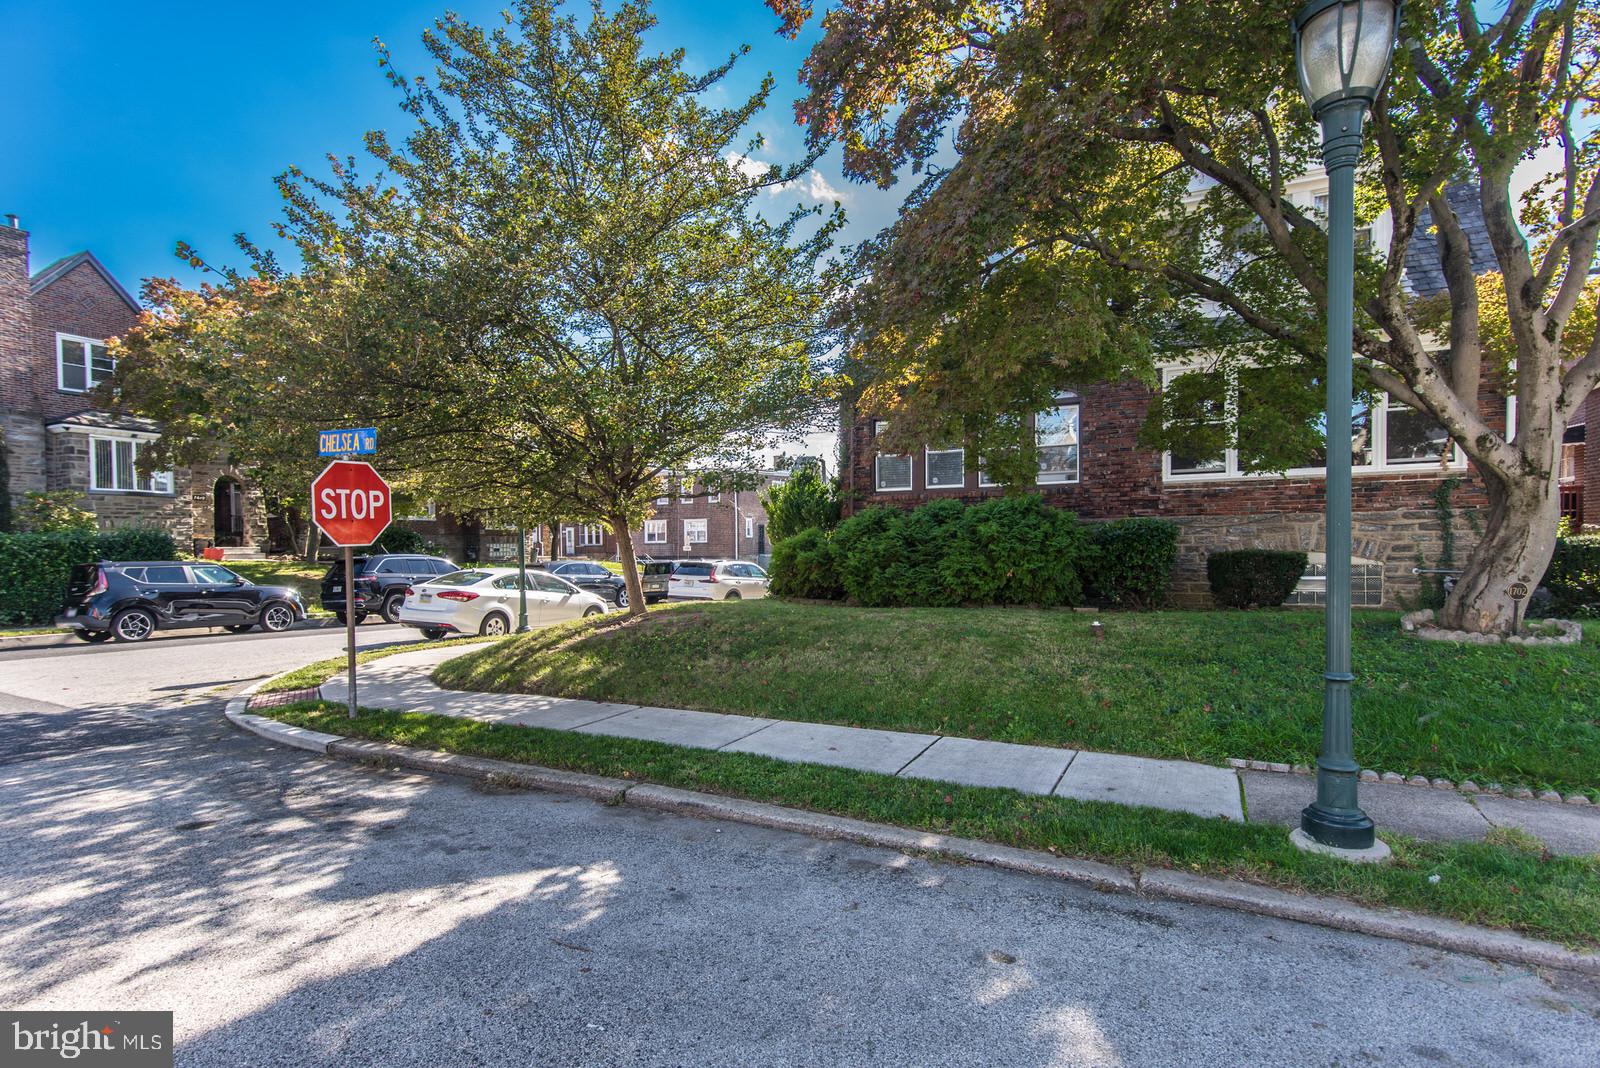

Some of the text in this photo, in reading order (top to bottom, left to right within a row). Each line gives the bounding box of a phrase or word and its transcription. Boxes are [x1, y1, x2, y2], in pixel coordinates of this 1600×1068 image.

[319, 433, 374, 453] CHELSEA RD
[320, 488, 385, 519] STOP
[1509, 586, 1527, 595] 1702
